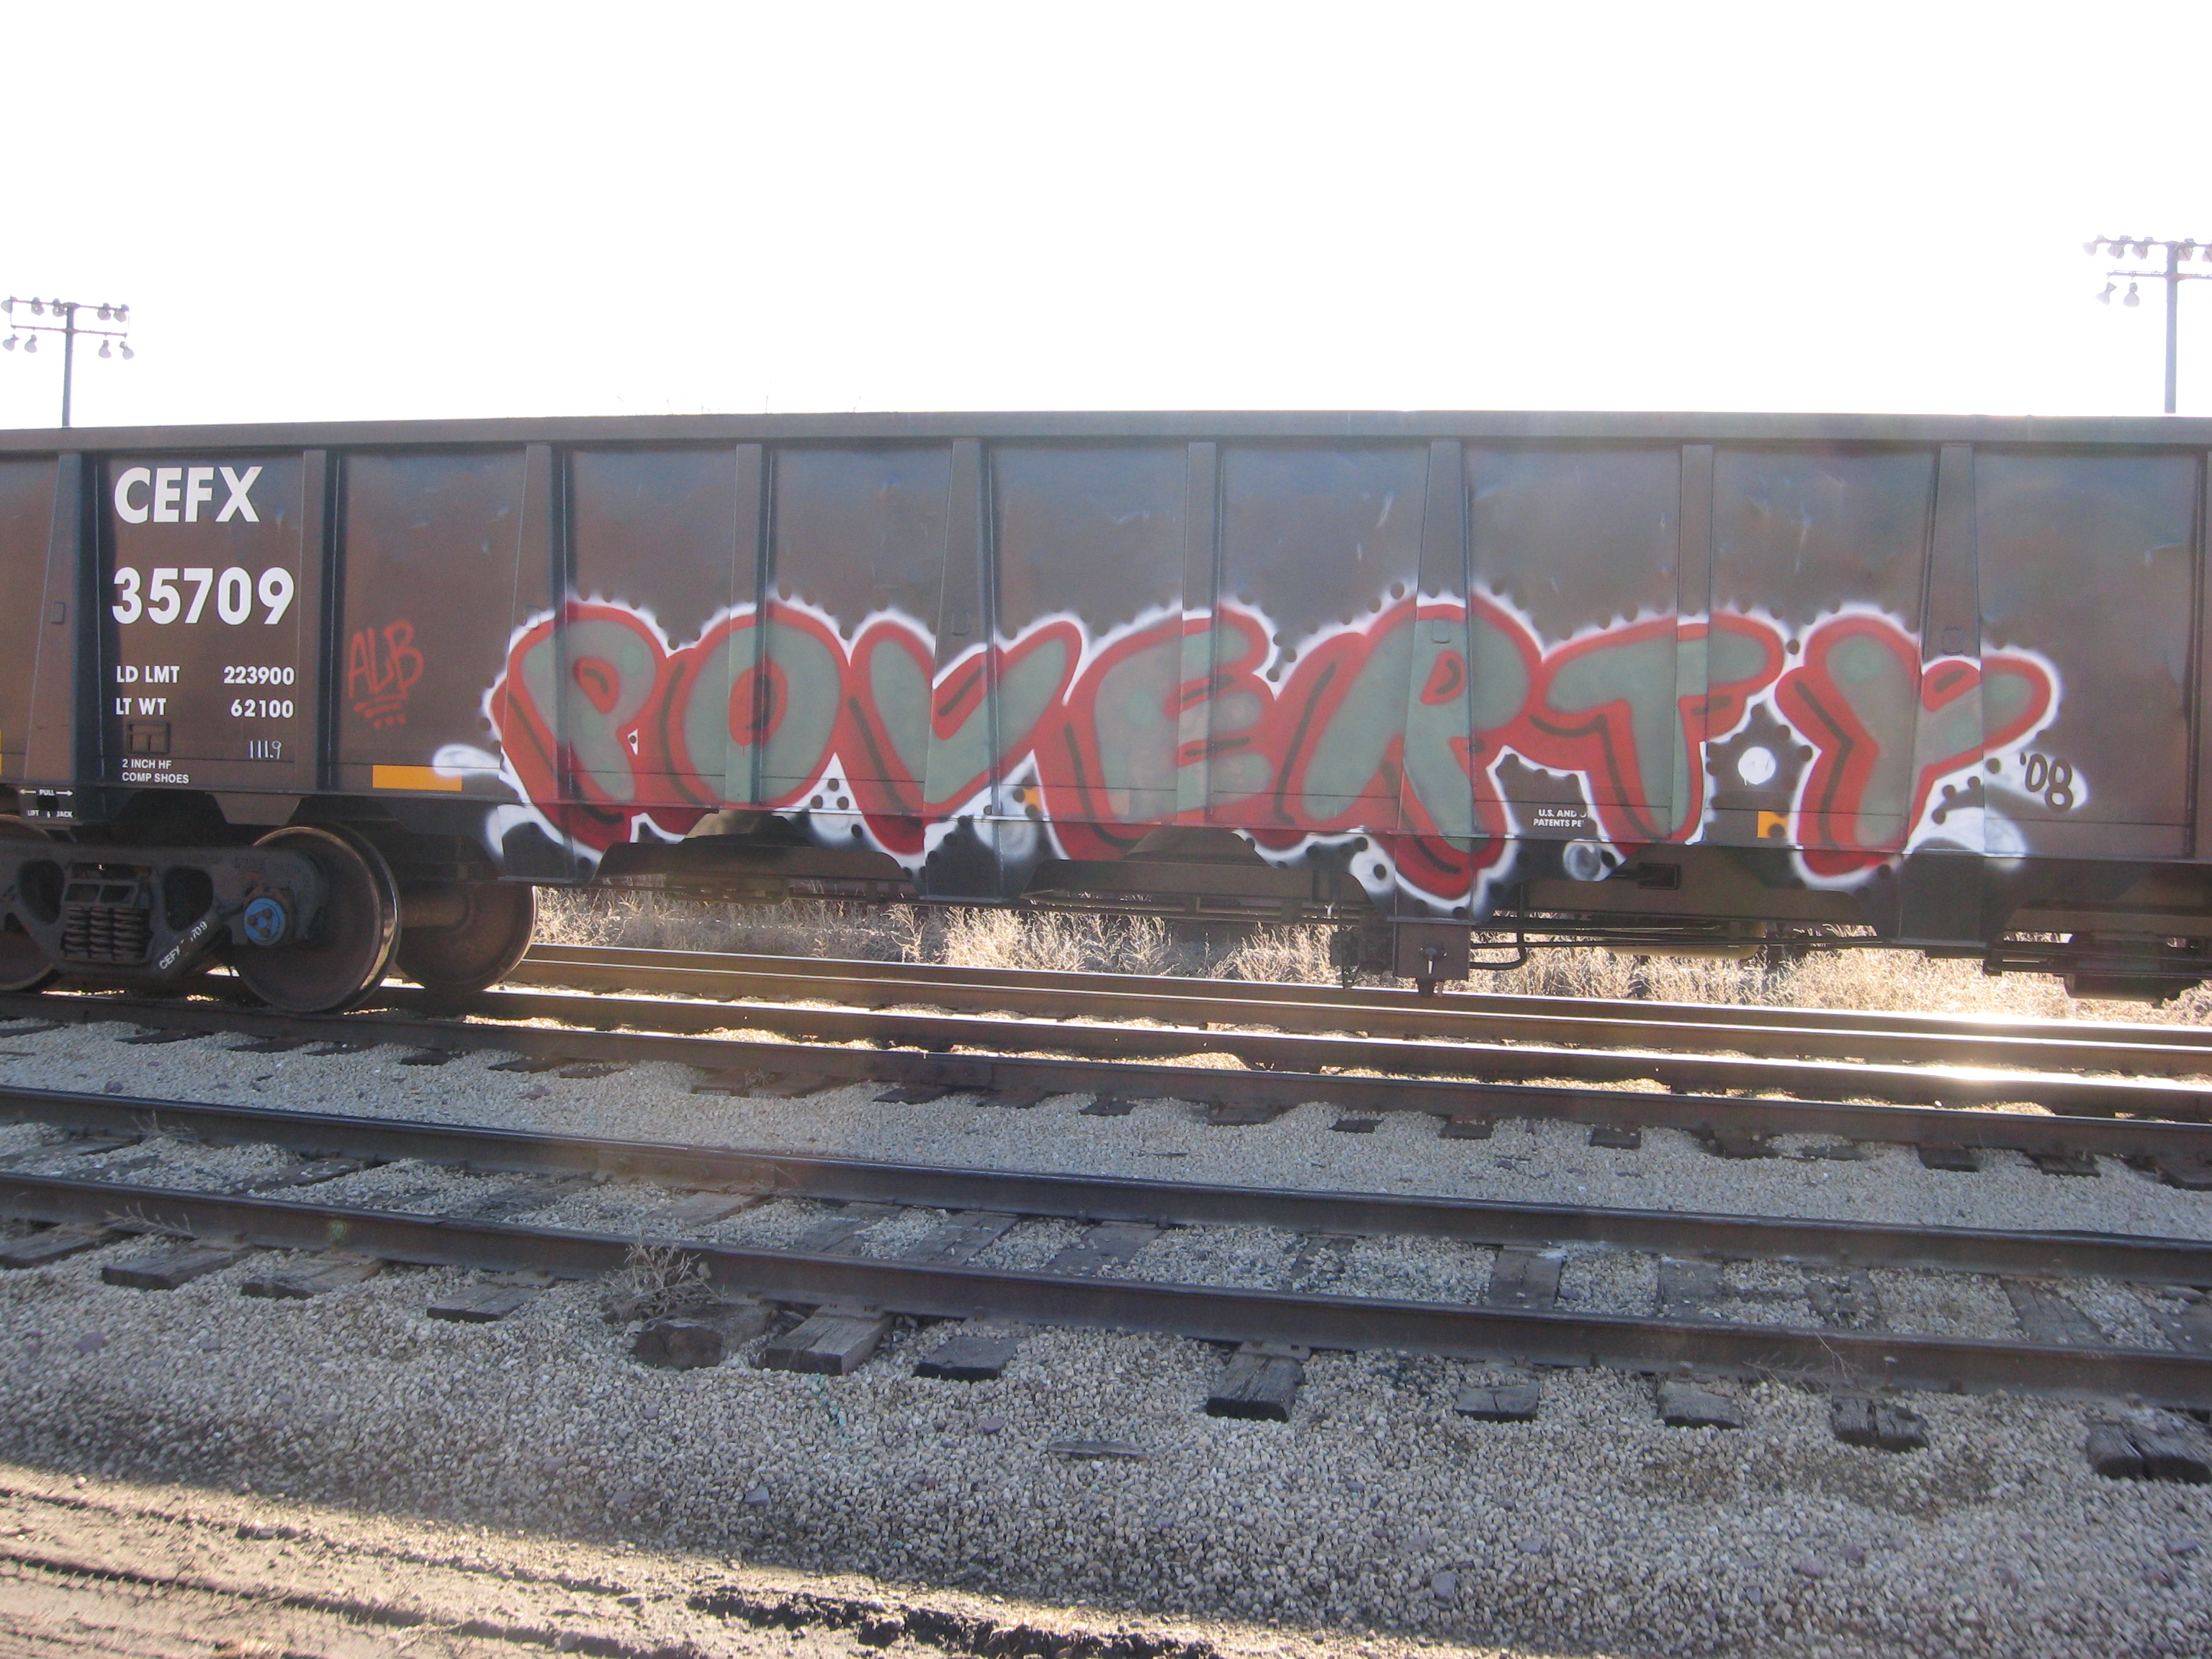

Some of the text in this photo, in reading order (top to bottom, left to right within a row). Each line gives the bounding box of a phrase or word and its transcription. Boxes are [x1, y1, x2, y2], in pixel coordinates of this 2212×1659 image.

[114, 466, 264, 524] CEFX
[112, 566, 295, 626] 35709
[347, 620, 425, 698] ALB
[116, 665, 295, 685] LD LMT 223900
[115, 697, 295, 719] LT WT 62100
[485, 586, 2059, 910] POVERTY
[122, 758, 173, 770] 2 INCH HF
[122, 771, 190, 784] COMP SHOES
[1532, 818, 1570, 828] PATENTS
[1538, 809, 1555, 817] U.S.
[1556, 809, 1578, 818] AND
